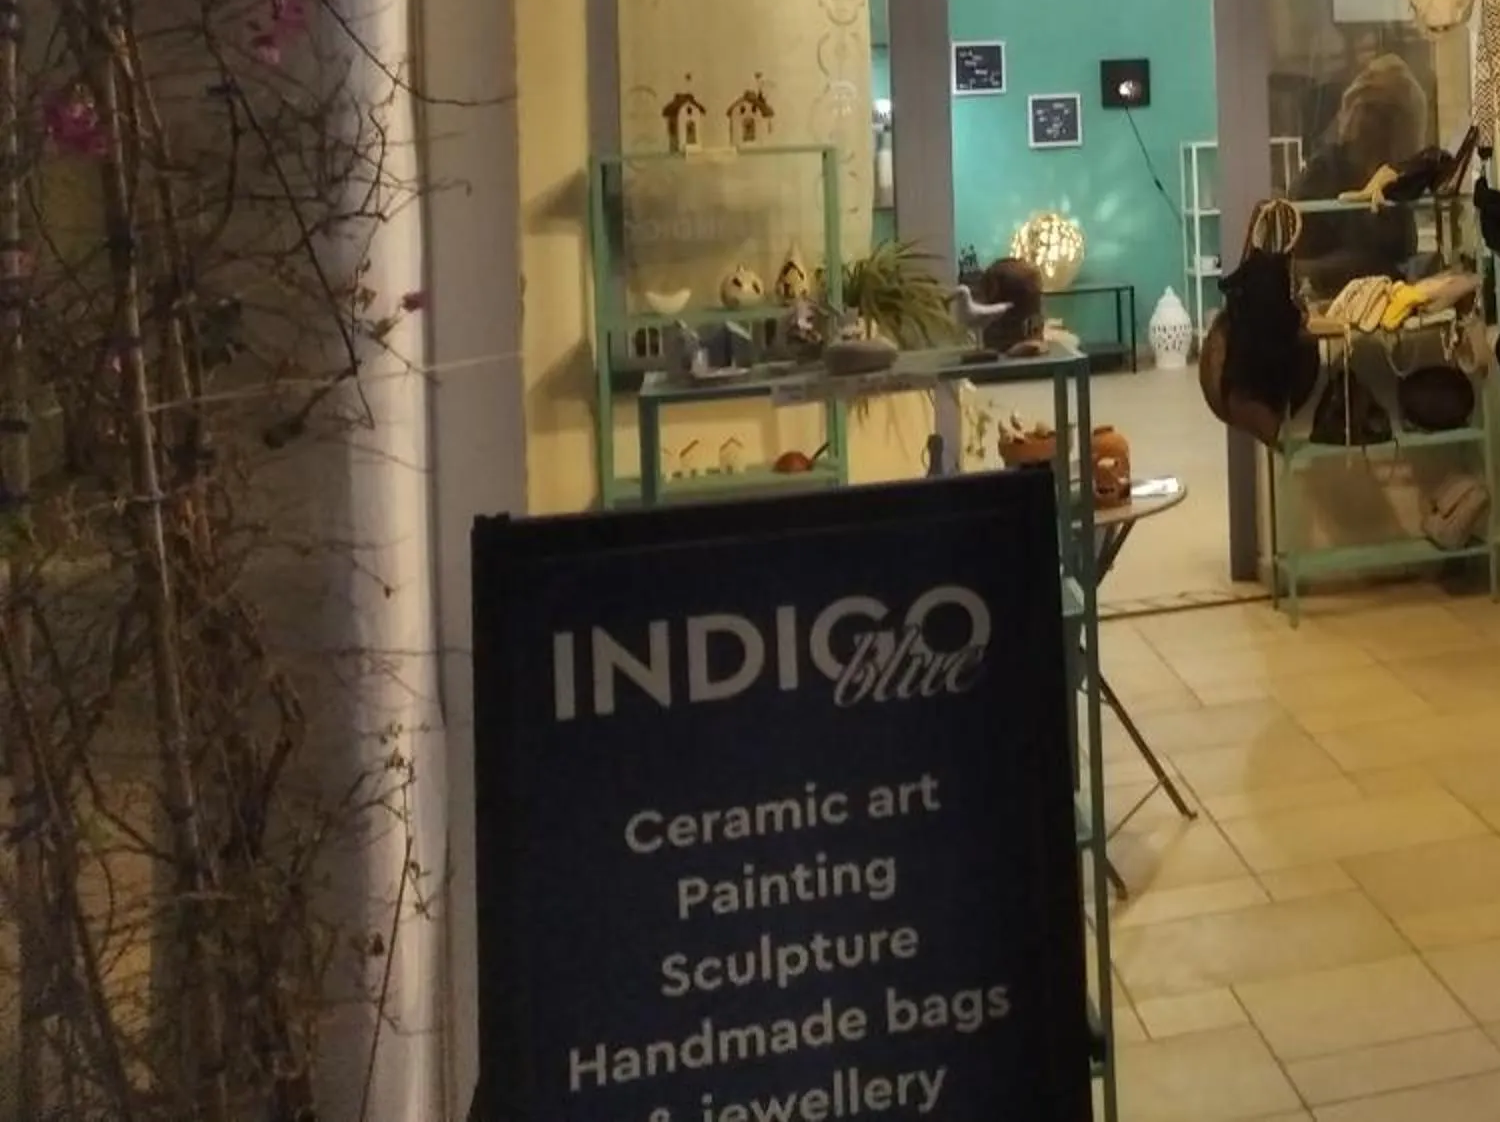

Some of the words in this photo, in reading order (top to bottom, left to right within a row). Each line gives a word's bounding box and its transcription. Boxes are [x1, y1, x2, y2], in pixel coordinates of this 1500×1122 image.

[553, 584, 991, 721] INDIGO
[833, 623, 986, 708] blue
[624, 782, 850, 854] Ceramic
[867, 773, 941, 820] art
[678, 852, 898, 920] Painting
[660, 925, 920, 998] Sculpture
[568, 995, 868, 1092] Handmade
[886, 983, 1012, 1033] bags
[700, 1065, 948, 1122] jewellery
